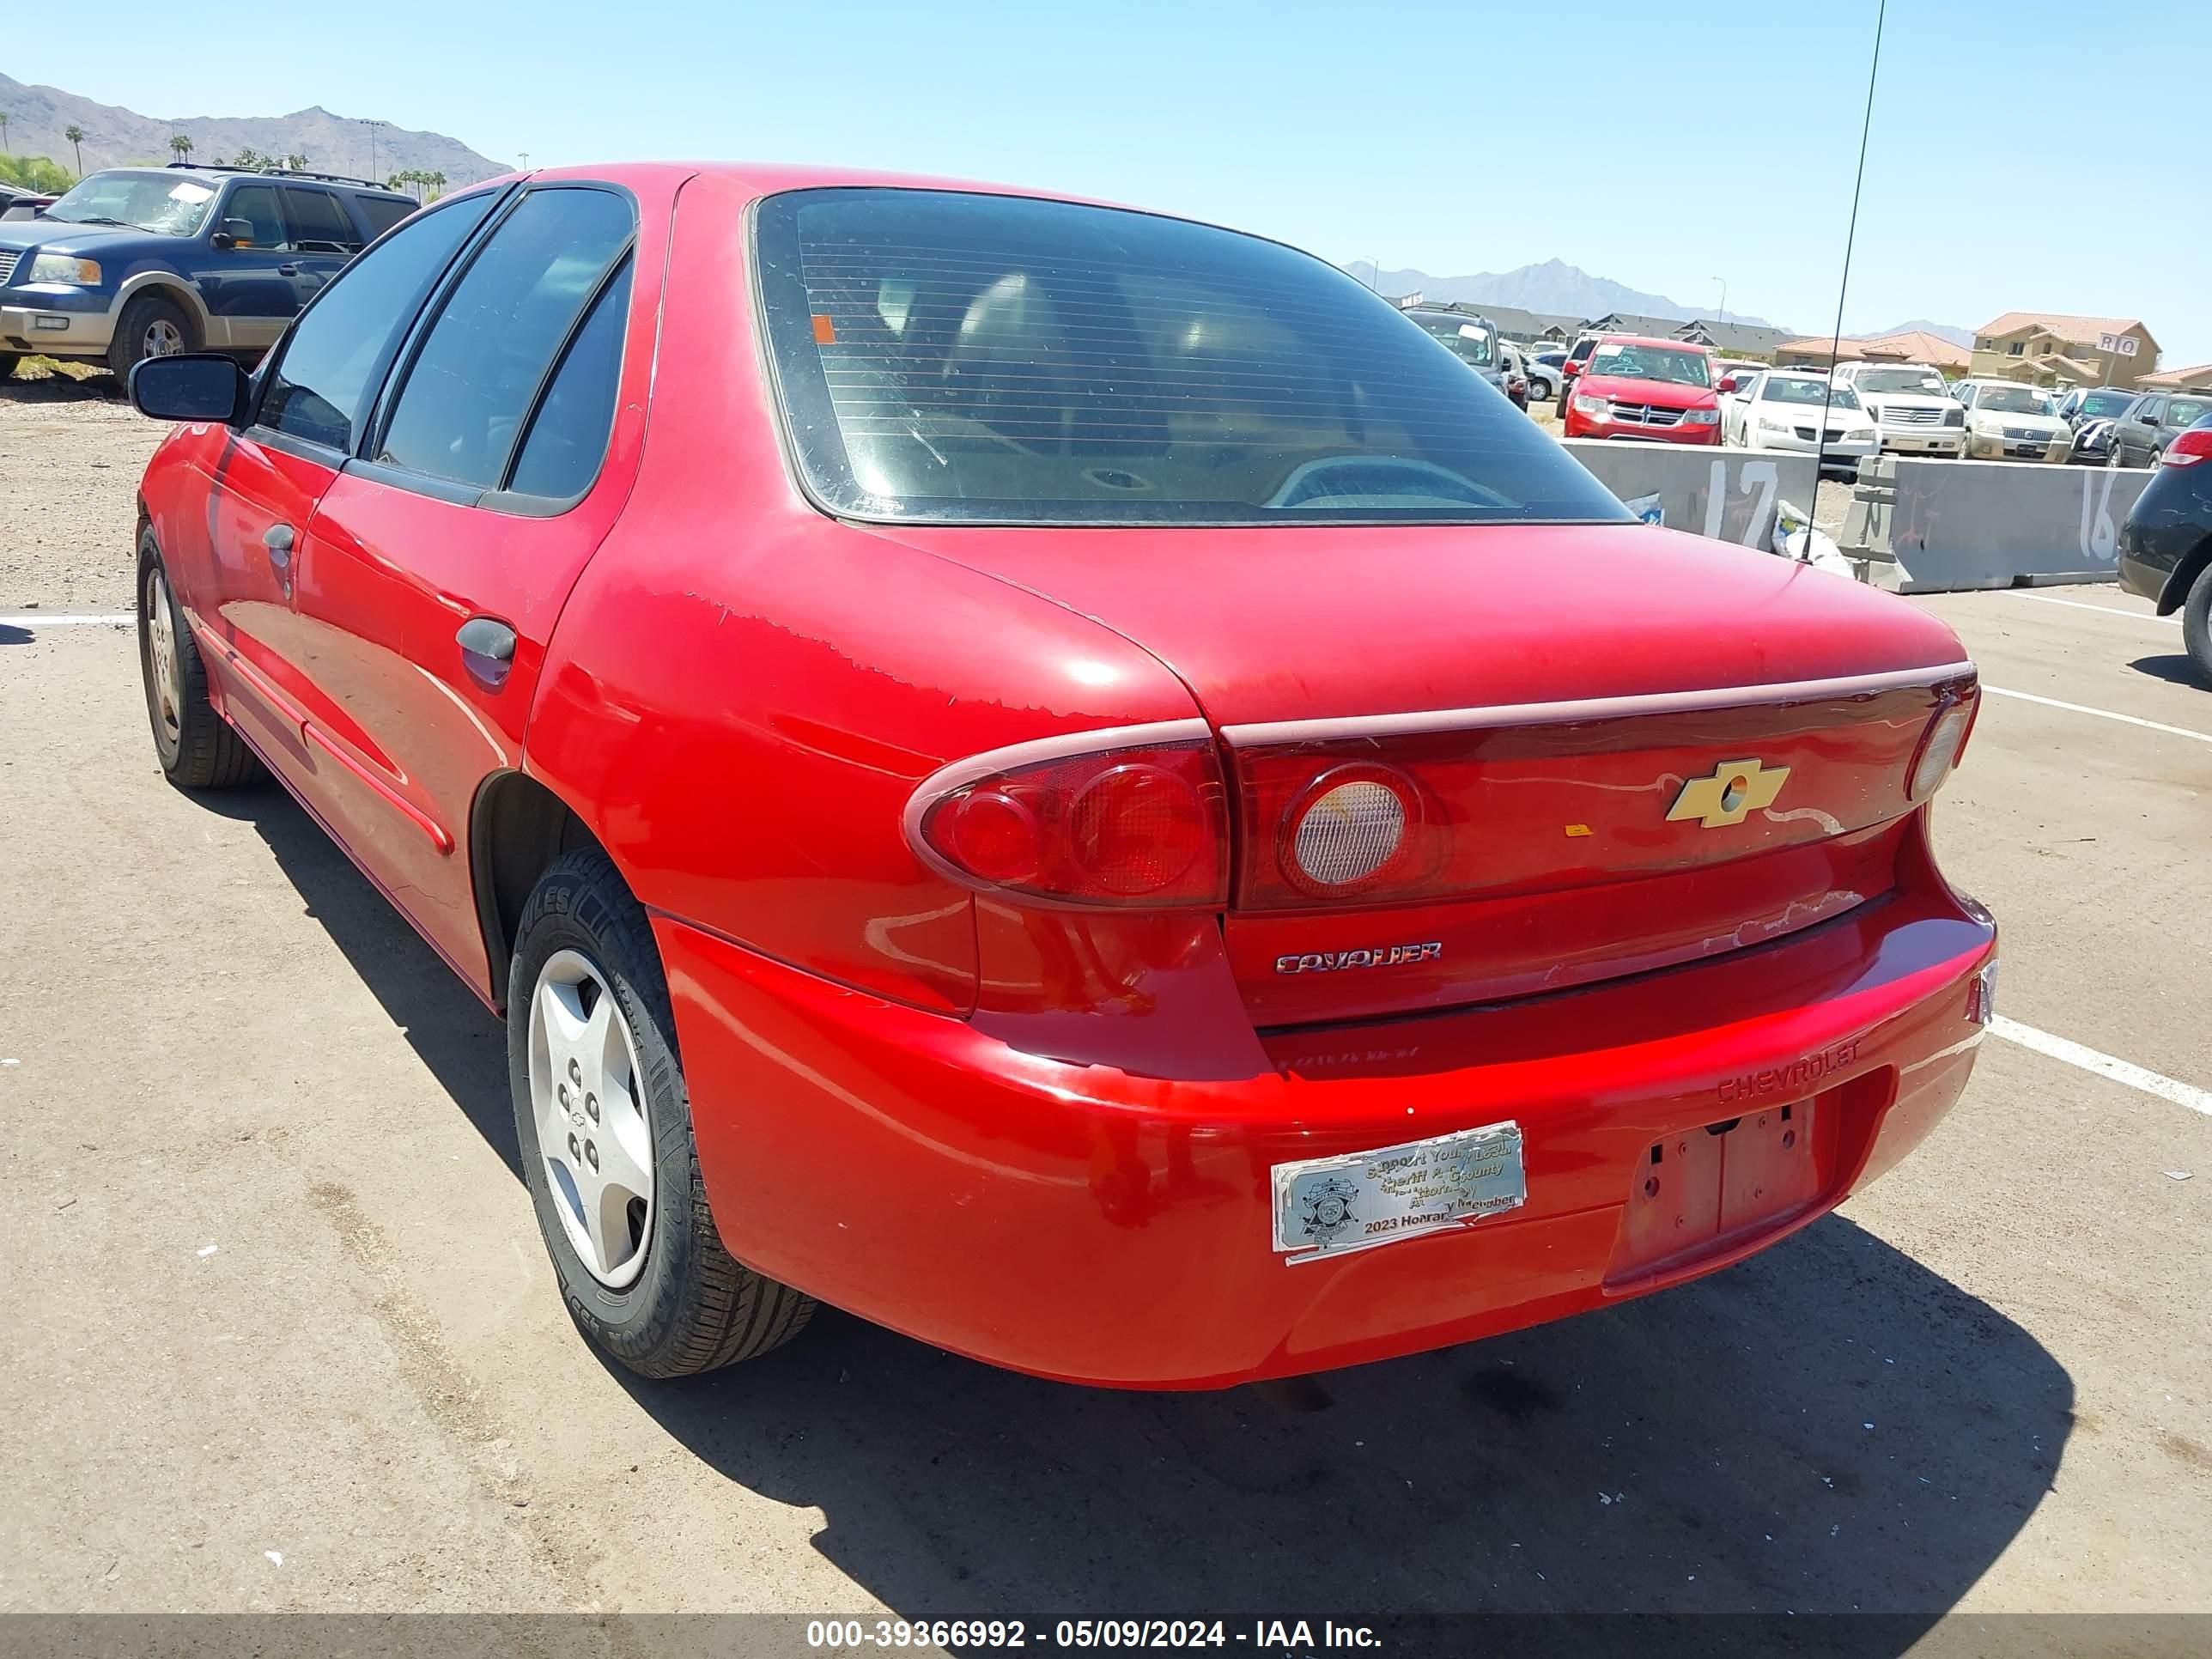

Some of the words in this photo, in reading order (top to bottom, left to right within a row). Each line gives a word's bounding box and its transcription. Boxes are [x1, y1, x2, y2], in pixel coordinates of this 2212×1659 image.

[2101, 336, 2112, 349] R
[1704, 459, 1778, 550] 17
[2080, 470, 2115, 560] 16
[1276, 941, 1443, 975] CAVALIER
[1717, 1039, 1862, 1104] CHEVROLET
[1364, 1218, 1398, 1234] 2023
